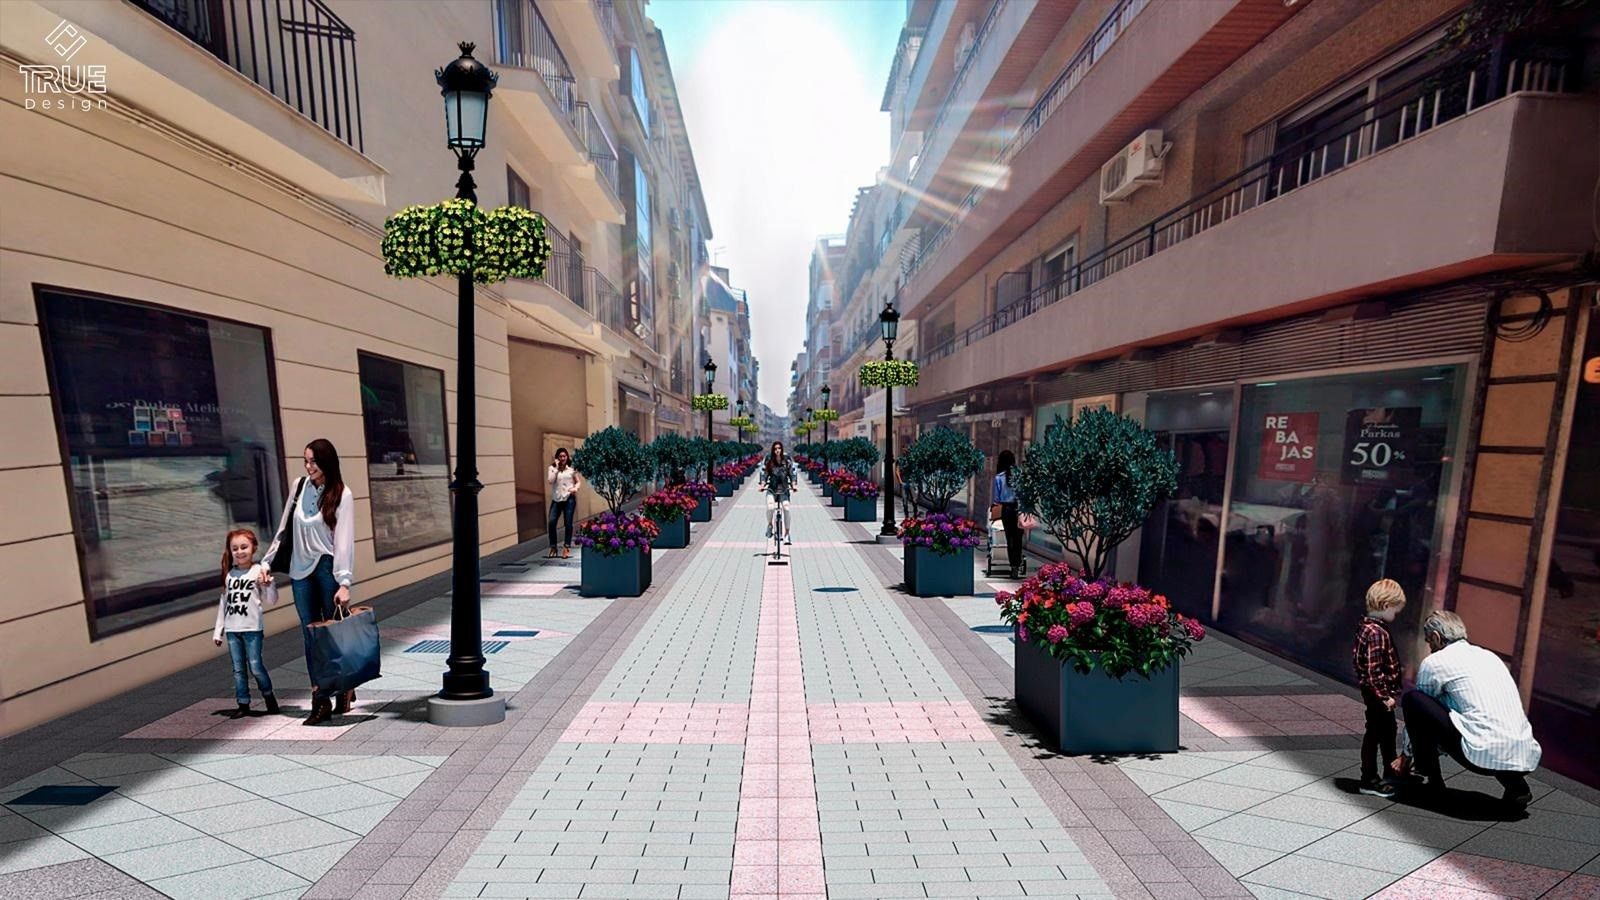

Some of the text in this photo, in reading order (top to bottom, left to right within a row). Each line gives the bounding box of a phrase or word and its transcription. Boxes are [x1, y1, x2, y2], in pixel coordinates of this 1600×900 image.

[1265, 416, 1289, 429] RE
[1275, 430, 1300, 444] BA
[1360, 428, 1401, 439] Parkas
[1280, 445, 1314, 461] JAS
[1350, 442, 1407, 467] 50%
[228, 578, 256, 591] LOVE
[224, 604, 248, 617] YORK
